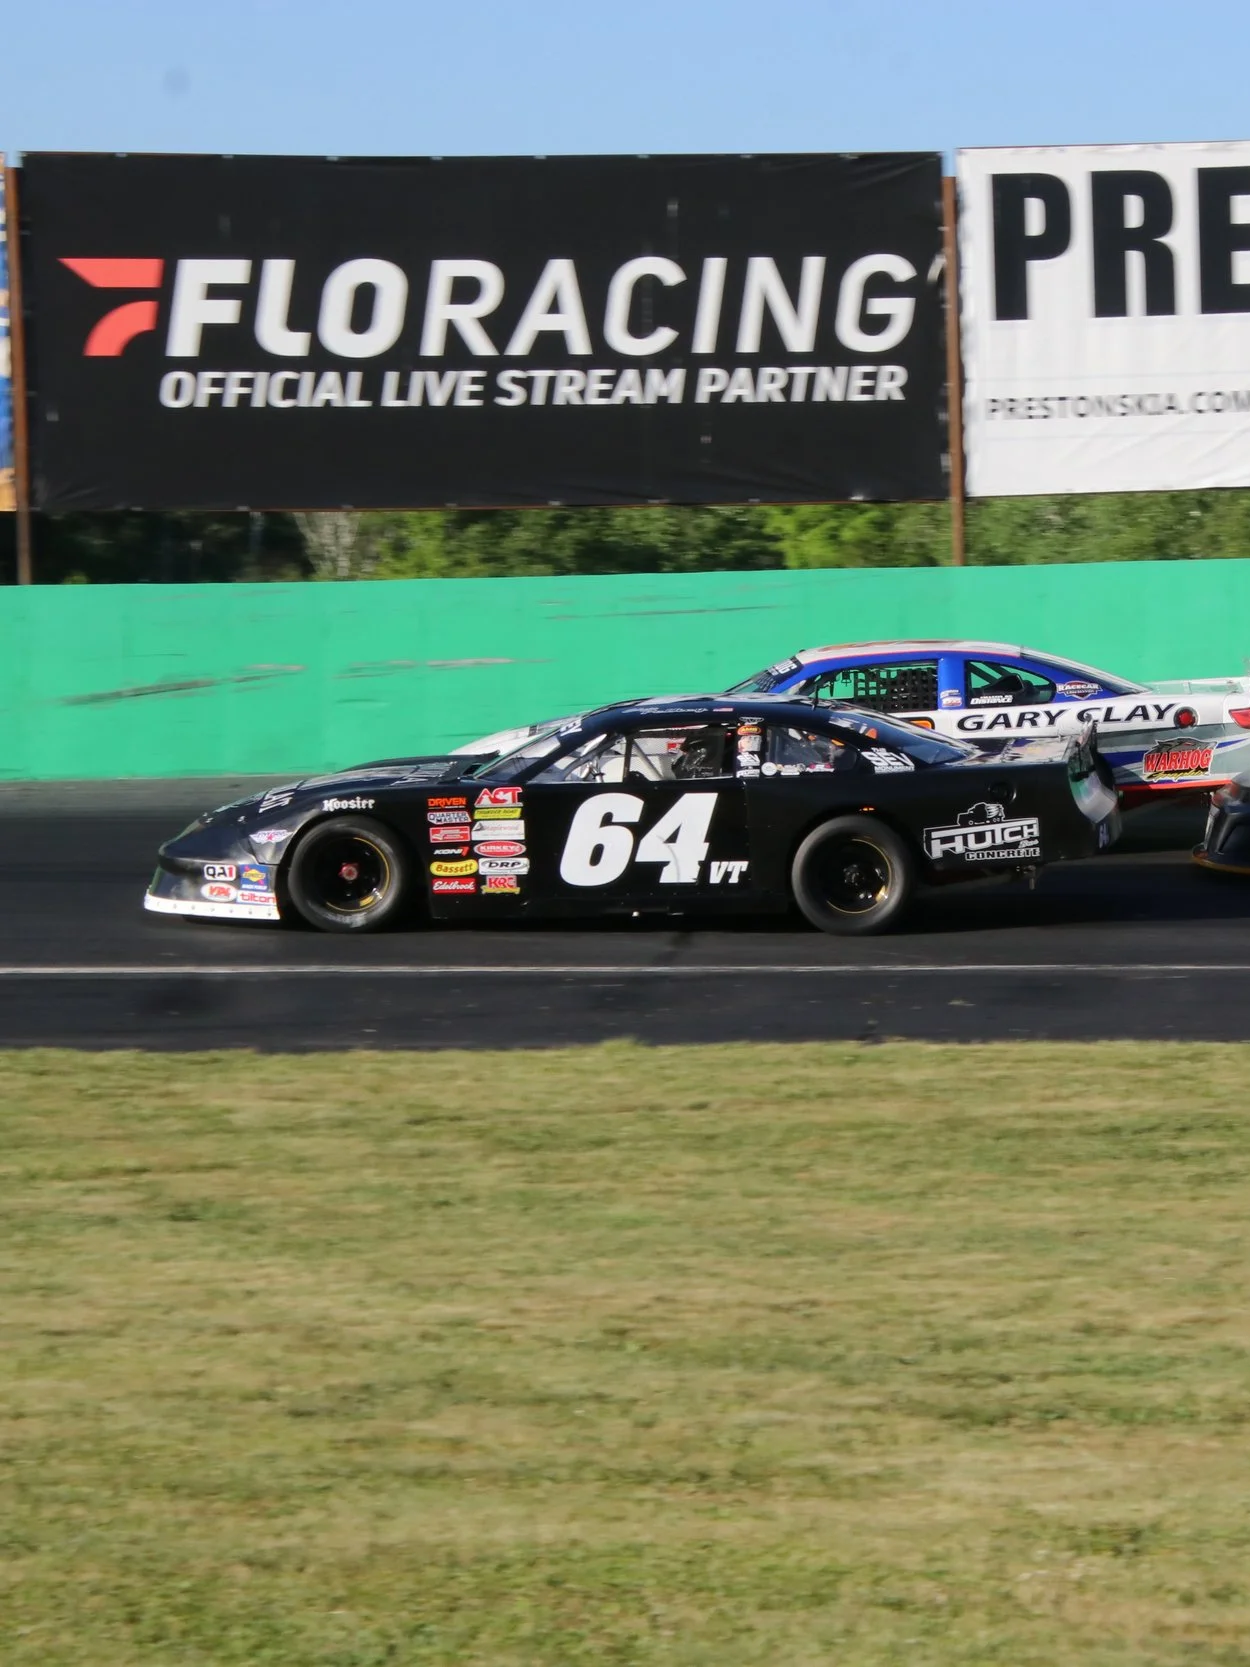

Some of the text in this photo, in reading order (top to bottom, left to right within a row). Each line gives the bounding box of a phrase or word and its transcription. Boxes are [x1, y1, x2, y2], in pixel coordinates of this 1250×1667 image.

[165, 254, 917, 358] FLORACING
[160, 364, 908, 408] OFFICIAL LIVE STREAM PARTNER
[957, 703, 1178, 732] GARY CLAY
[1145, 748, 1213, 773] WARHOG
[874, 765, 915, 774] MONUMENT
[427, 797, 466, 807] DRIVEN
[475, 787, 522, 805] ACT
[322, 797, 375, 812] Hoosier
[429, 812, 467, 820] QUARTER
[559, 792, 748, 887] 64 VT
[931, 820, 1039, 859] HUTCH
[965, 847, 1040, 861] CONCRETE
[206, 866, 234, 878] QA1
[435, 862, 473, 873] Bassett
[488, 861, 521, 869] DRP
[432, 881, 475, 890] Edelbrock
[240, 893, 277, 903] tilton
